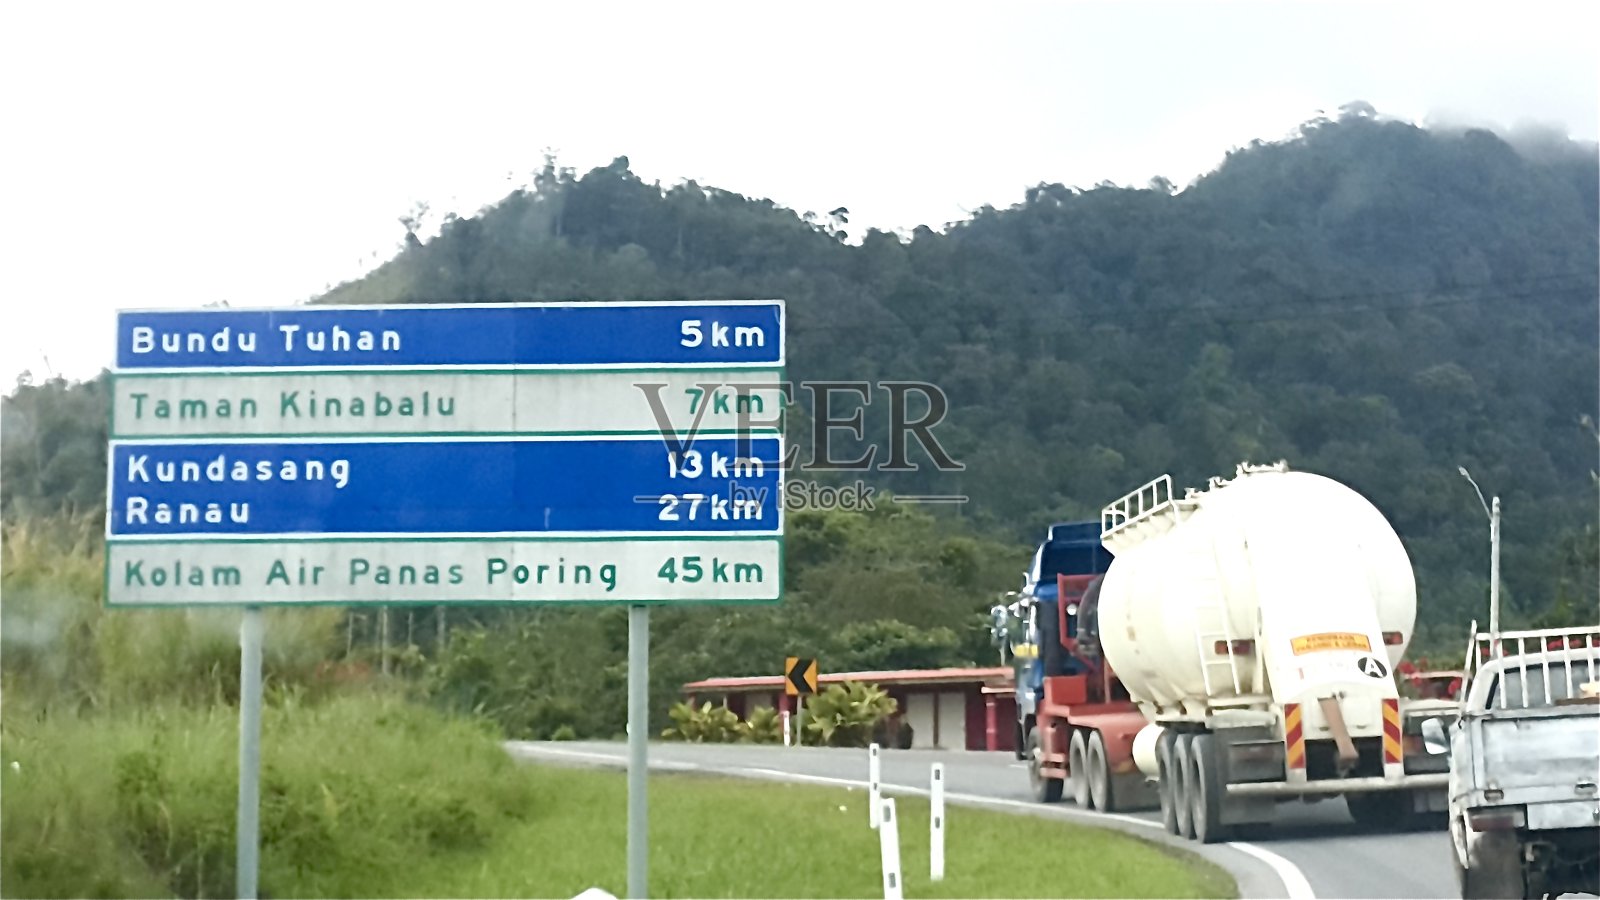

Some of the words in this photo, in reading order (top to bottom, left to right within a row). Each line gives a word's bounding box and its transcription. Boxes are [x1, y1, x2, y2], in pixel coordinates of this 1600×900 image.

[131, 326, 256, 353] Bundu
[279, 325, 401, 351] Tuhan
[130, 393, 257, 419] Taman
[279, 390, 454, 418] Kinabalu
[127, 454, 350, 488] Kundasang
[126, 496, 249, 524] Ranau
[125, 560, 242, 587] Kolam
[265, 559, 325, 586] Air
[350, 557, 464, 585] Panas
[487, 557, 617, 592] Poring
[1362, 657, 1384, 678] A
